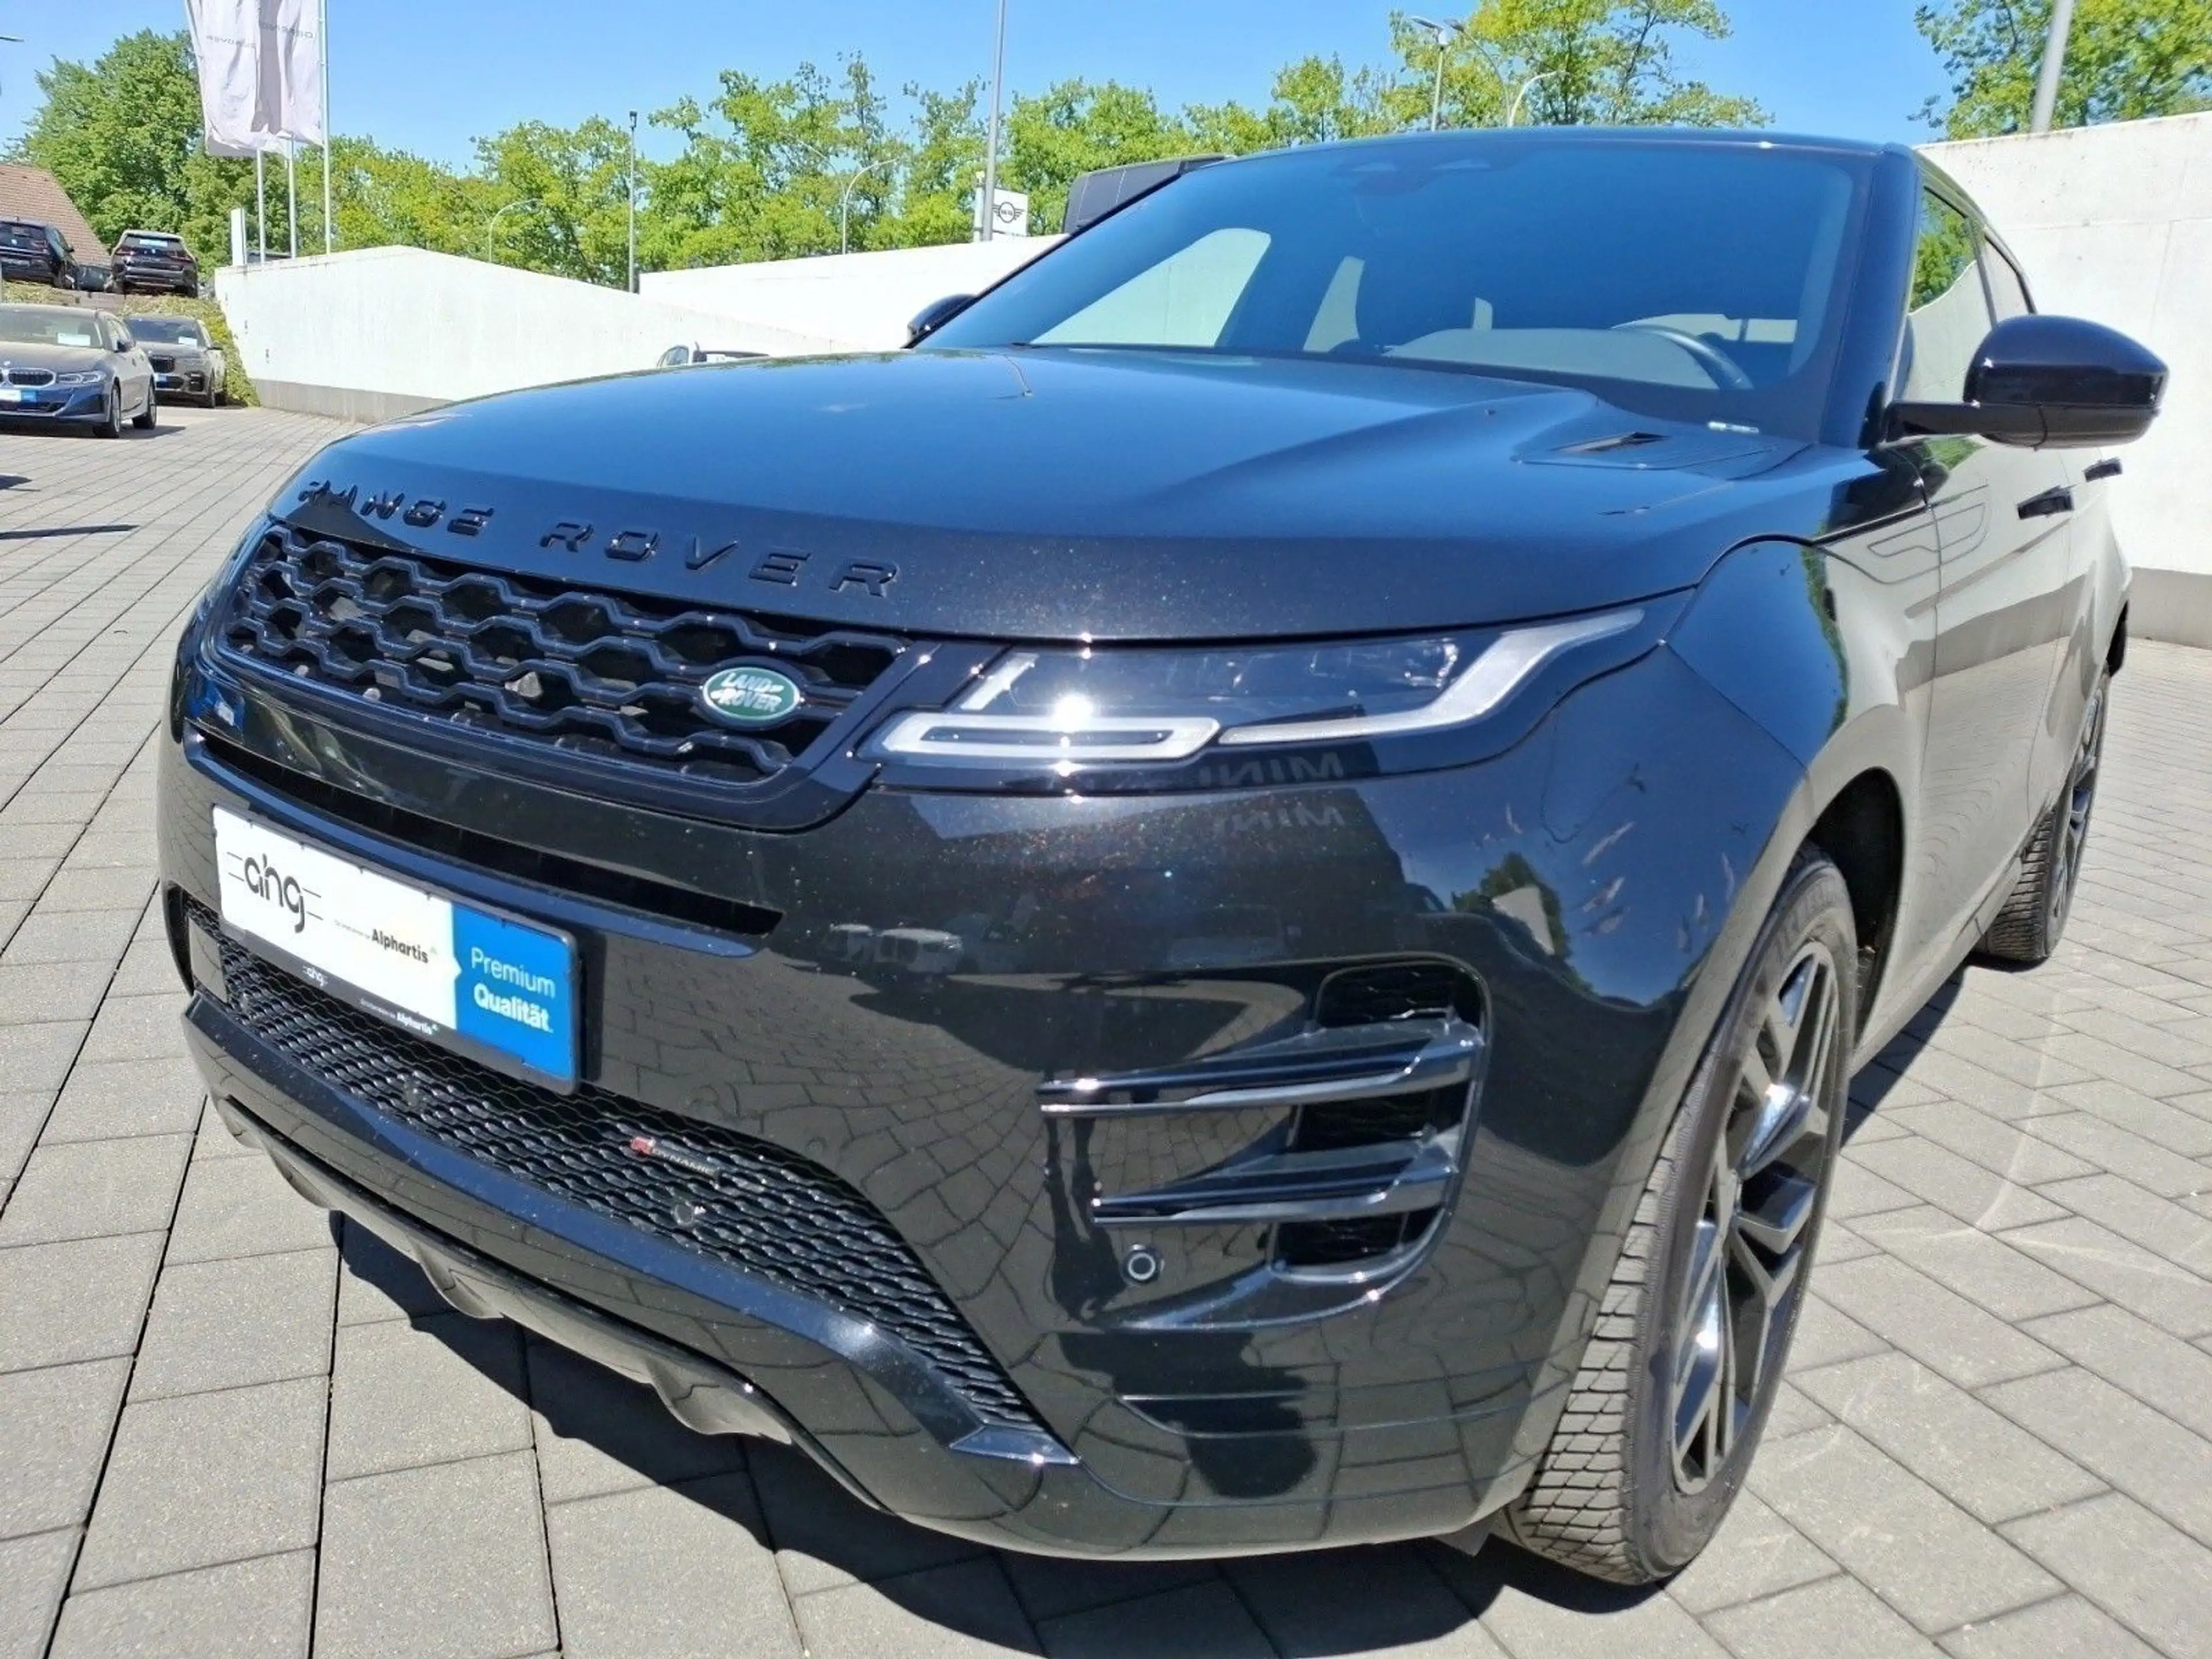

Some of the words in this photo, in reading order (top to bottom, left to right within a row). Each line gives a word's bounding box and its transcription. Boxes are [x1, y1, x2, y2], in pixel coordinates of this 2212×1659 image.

[539, 522, 900, 597] ROVER
[718, 688, 782, 712] ROVER
[721, 672, 773, 692] LAND
[244, 853, 305, 934] ahg
[372, 928, 429, 964] Alphartis
[471, 946, 556, 999] Premium
